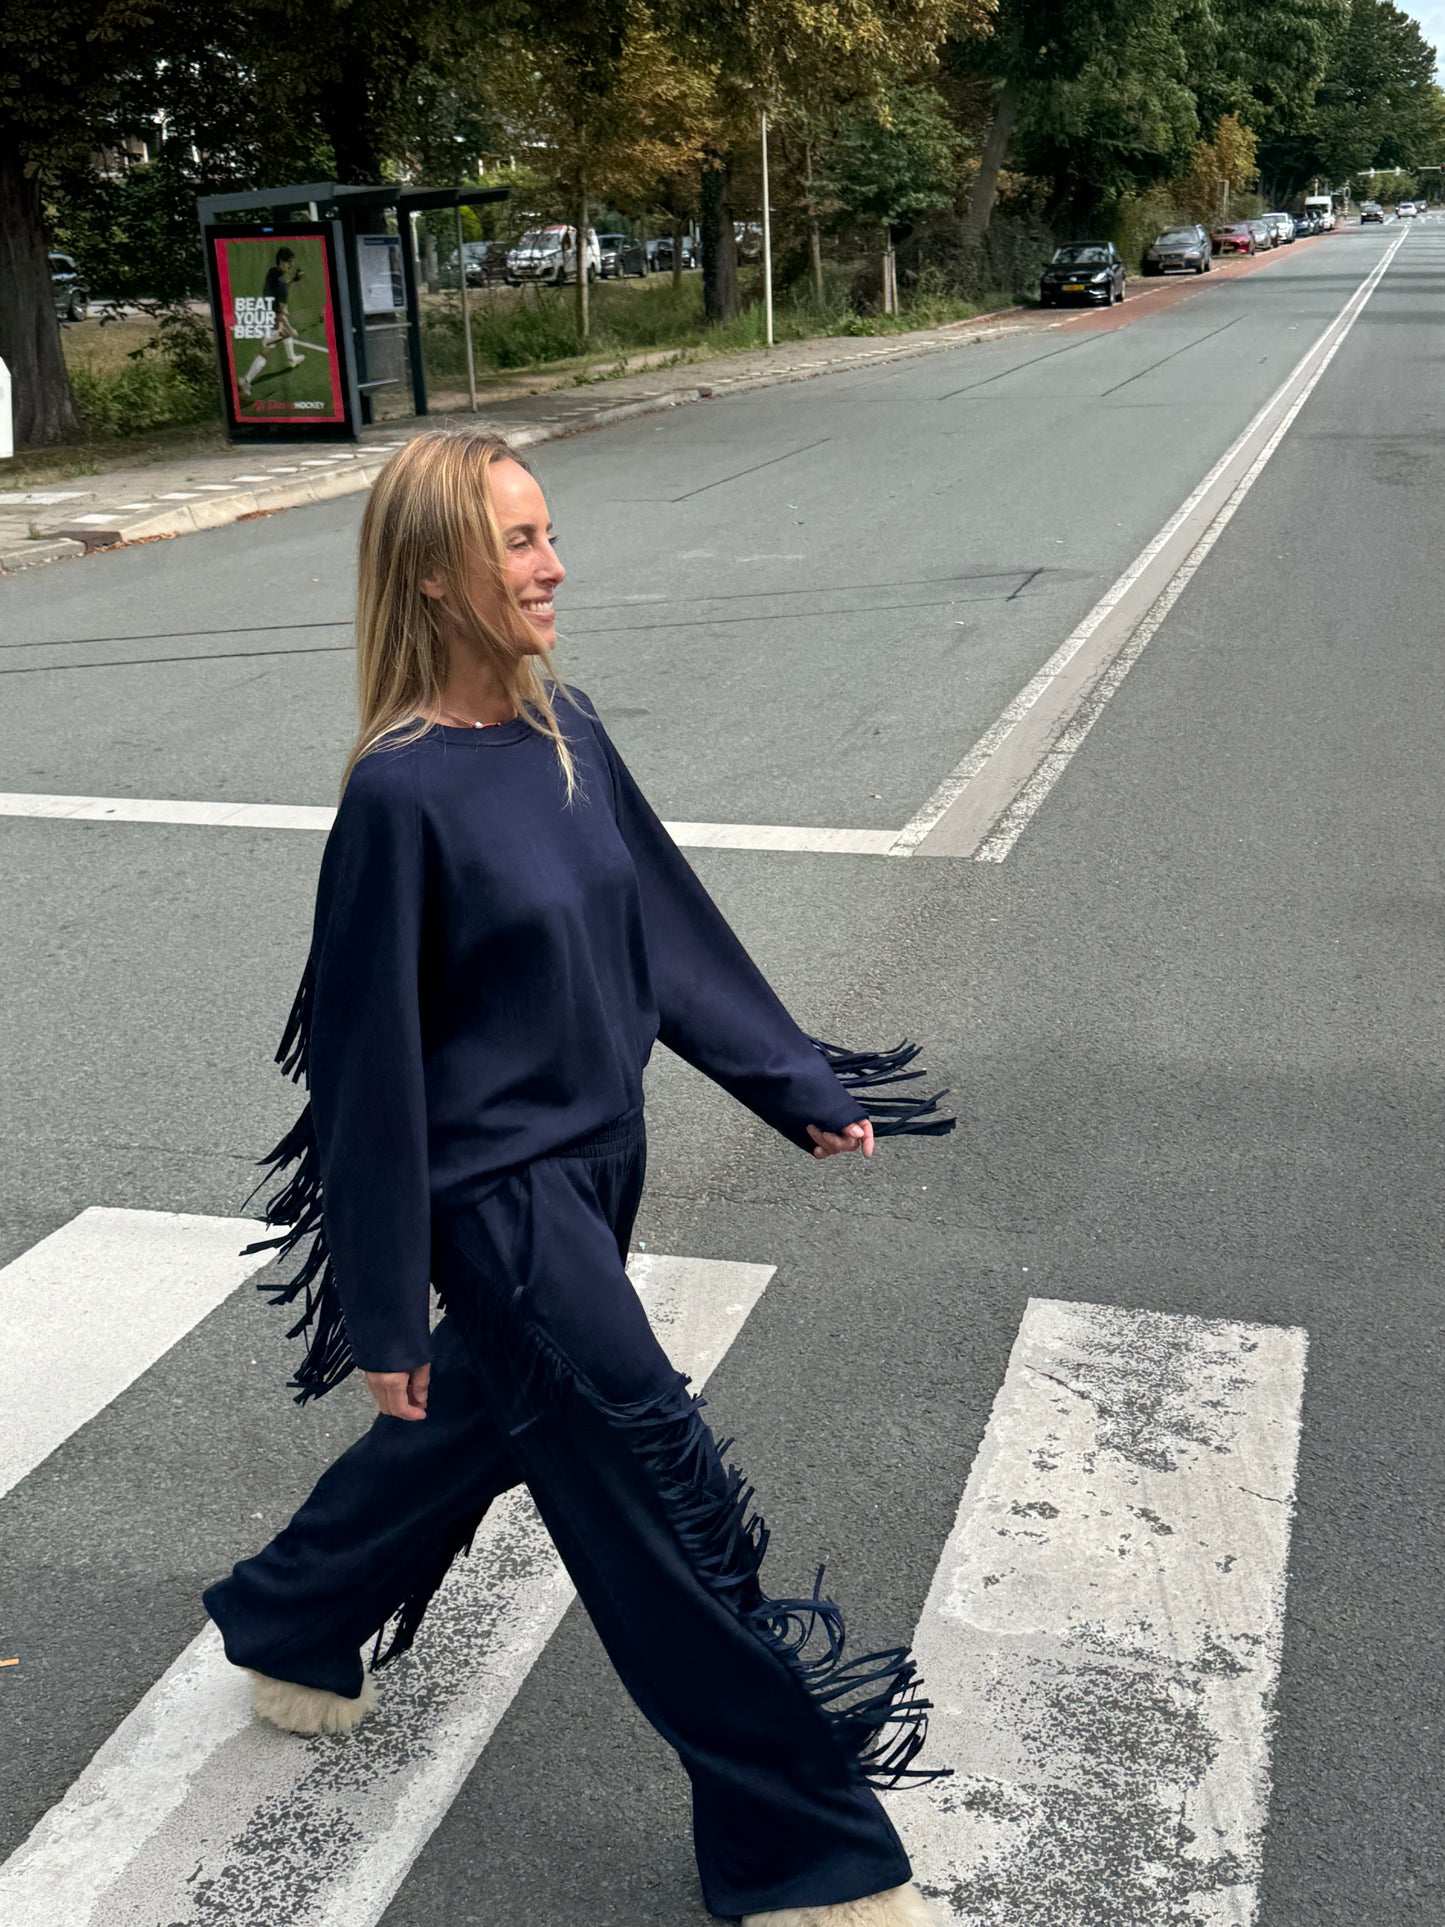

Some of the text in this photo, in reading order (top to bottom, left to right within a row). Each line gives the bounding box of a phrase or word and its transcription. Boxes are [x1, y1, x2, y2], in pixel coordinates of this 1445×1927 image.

[235, 296, 275, 310] BEAT
[234, 310, 276, 325] YOUR
[234, 325, 274, 339] BEST
